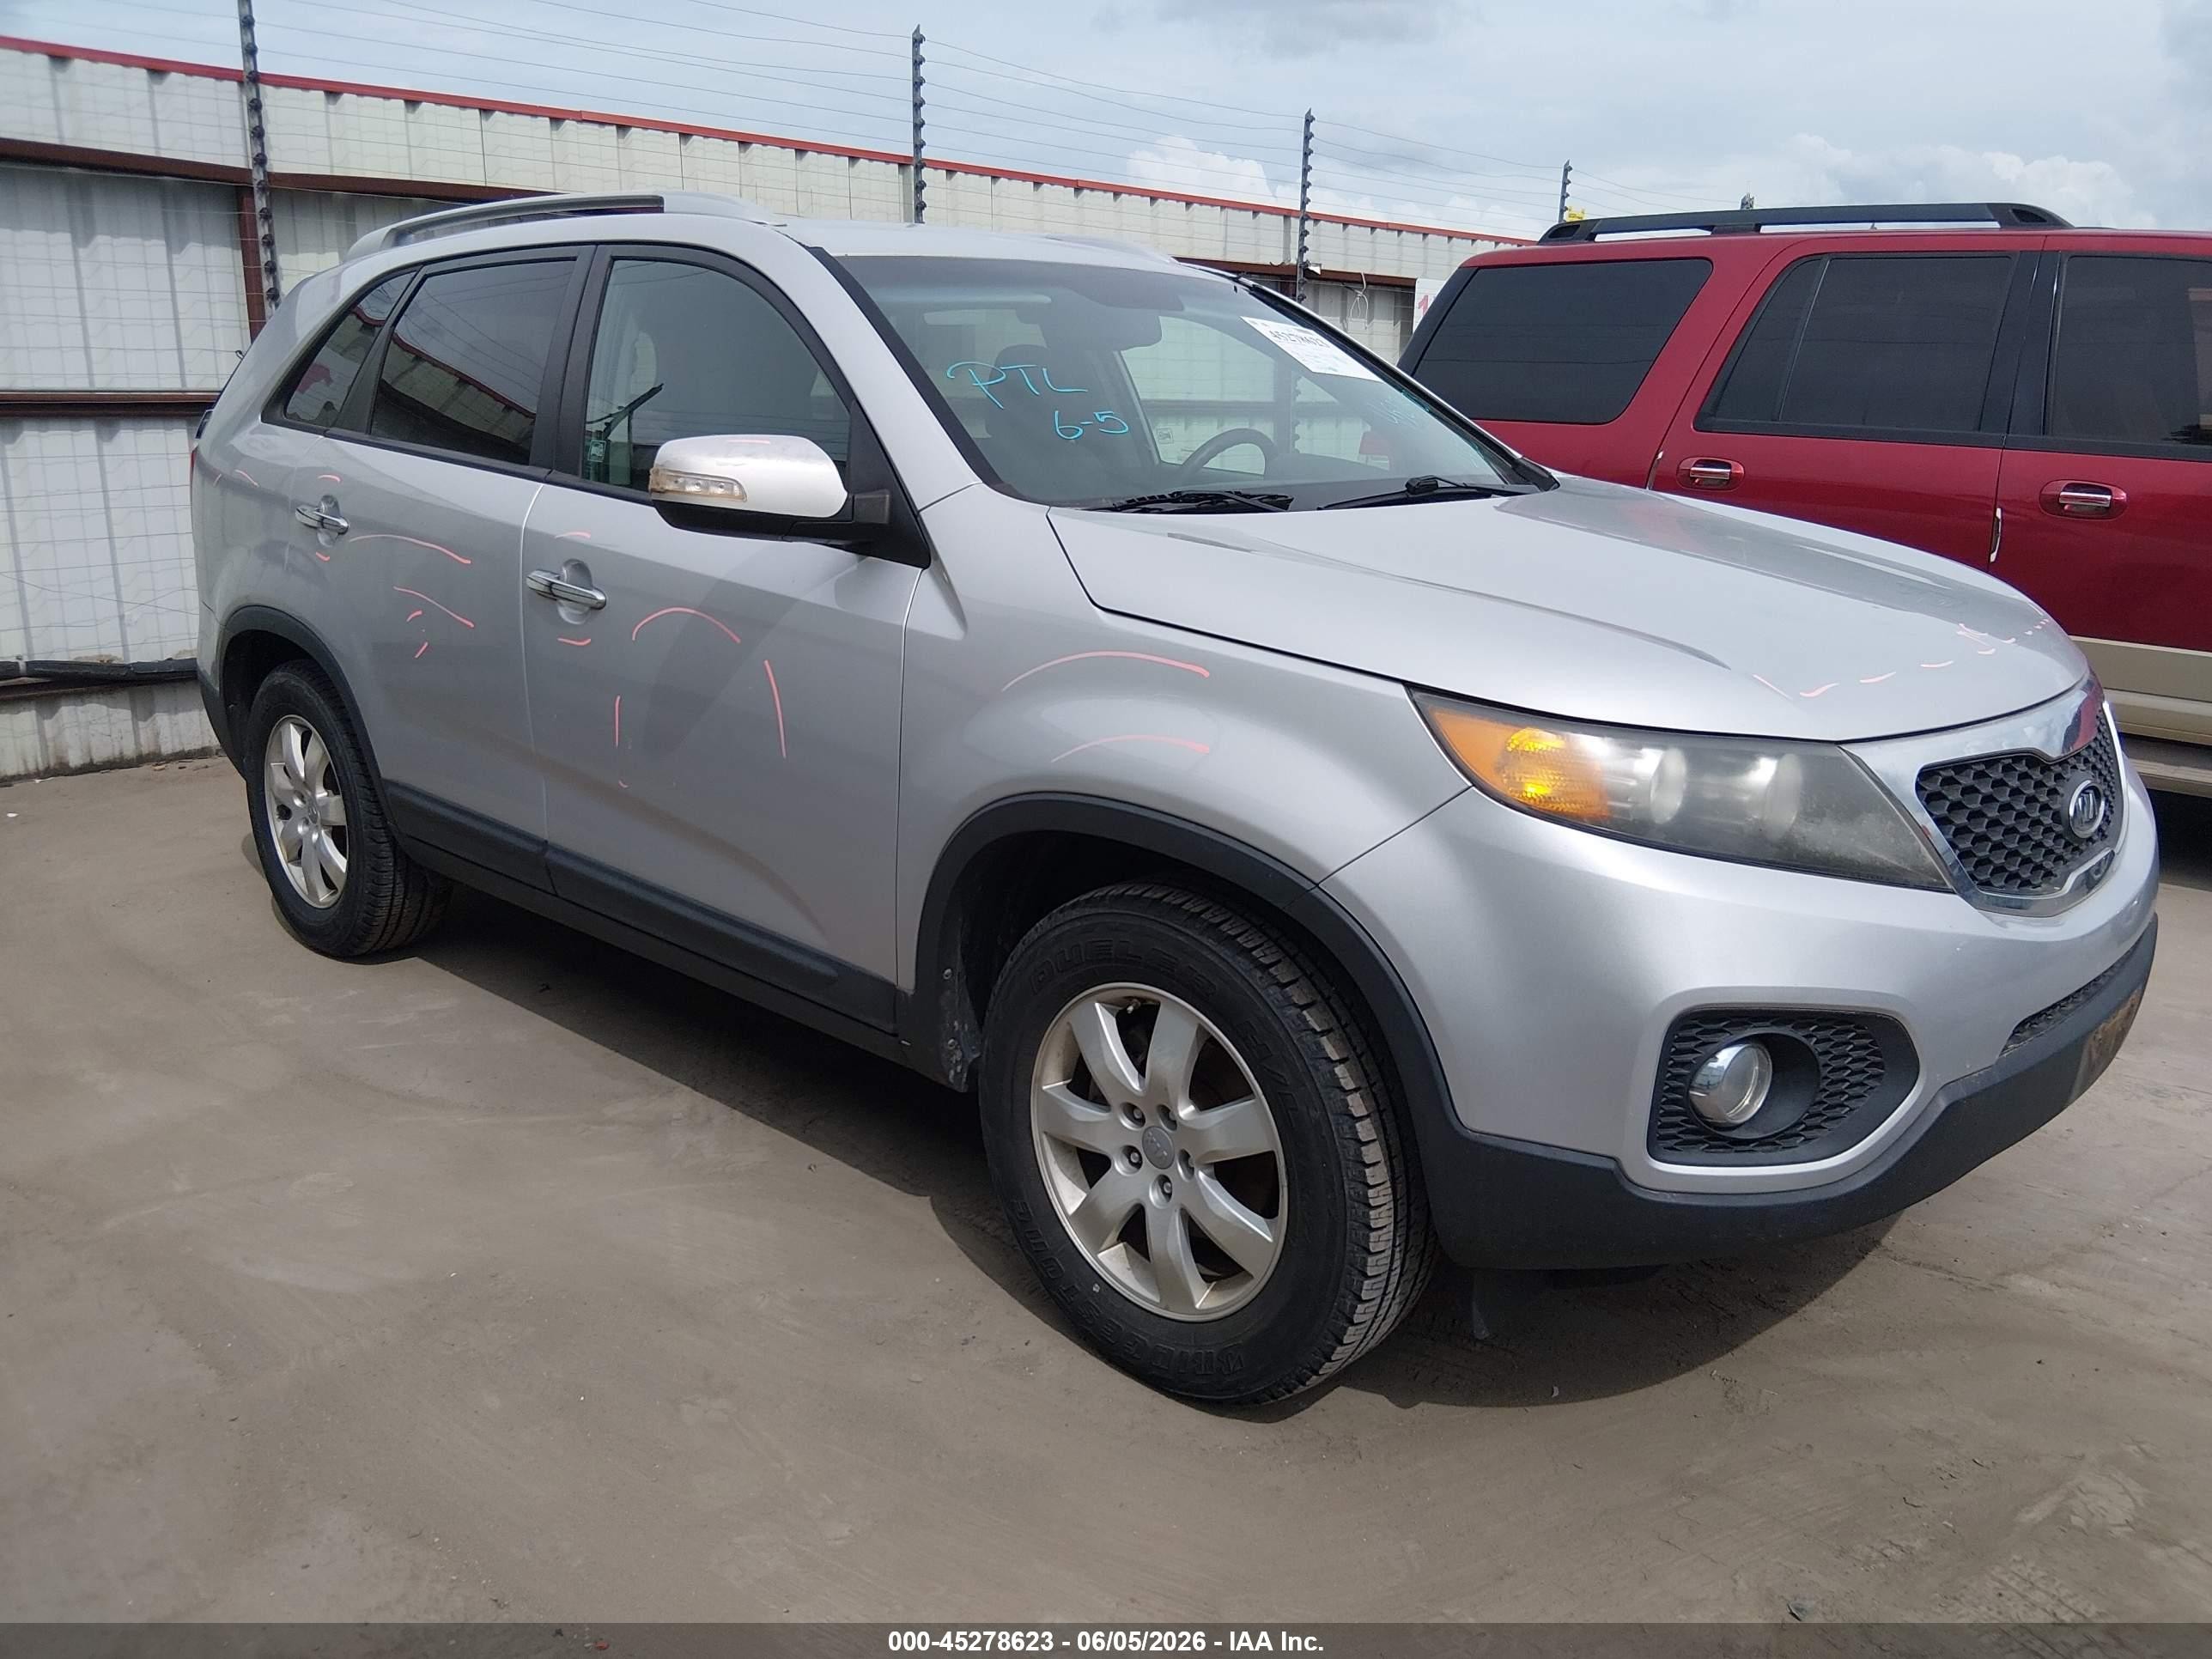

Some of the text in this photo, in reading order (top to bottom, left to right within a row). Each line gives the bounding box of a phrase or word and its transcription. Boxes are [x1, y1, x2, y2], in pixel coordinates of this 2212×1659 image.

[946, 361, 1088, 410] PTL
[1054, 410, 1129, 440] 6-5
[1030, 937, 1219, 999] DUELER
